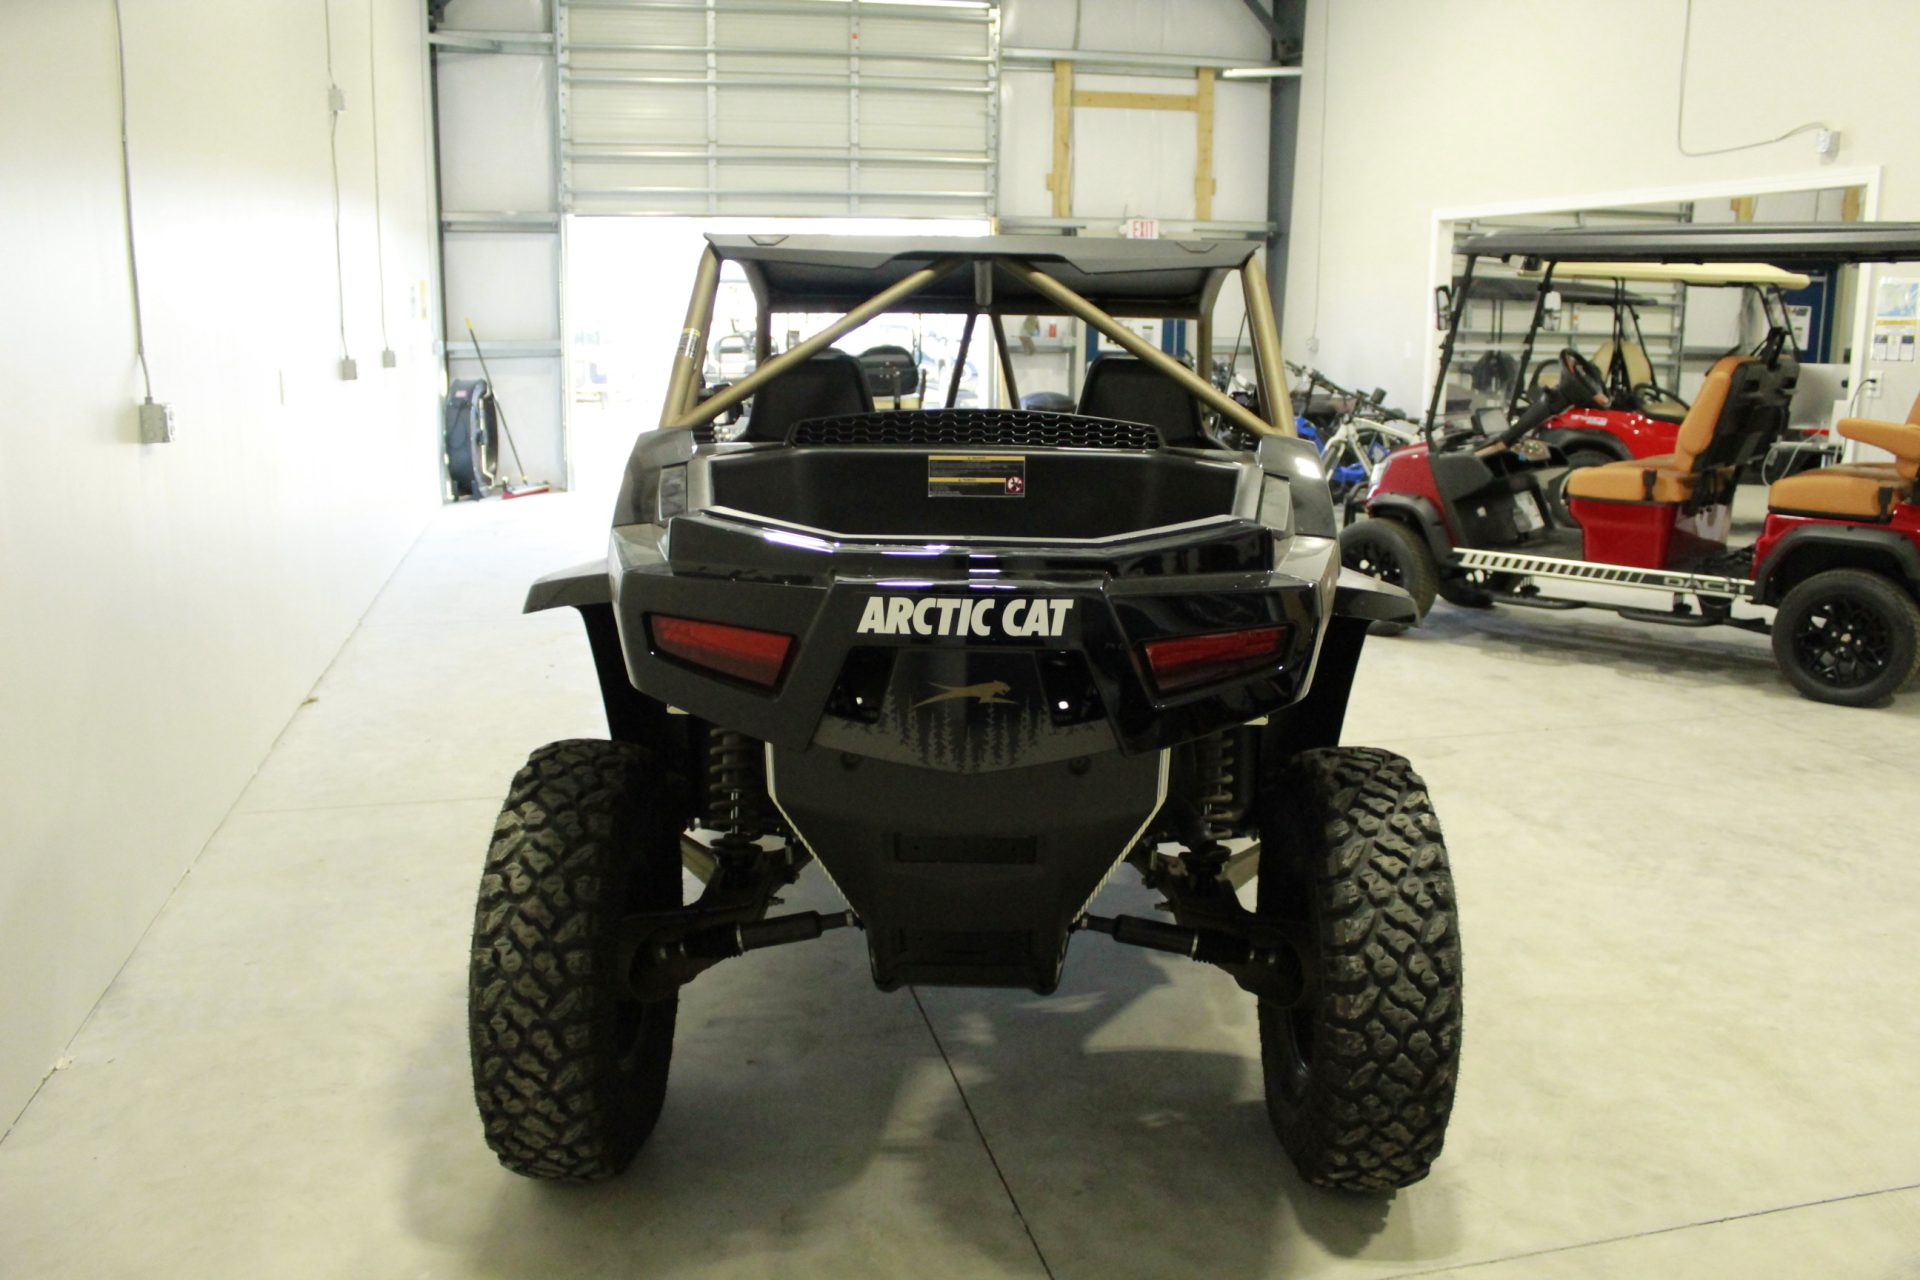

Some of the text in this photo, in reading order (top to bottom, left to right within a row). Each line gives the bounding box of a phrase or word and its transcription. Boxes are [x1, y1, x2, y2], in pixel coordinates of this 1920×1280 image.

[1133, 220, 1155, 239] EXIT
[857, 597, 1074, 636] ARCTIC CAT
